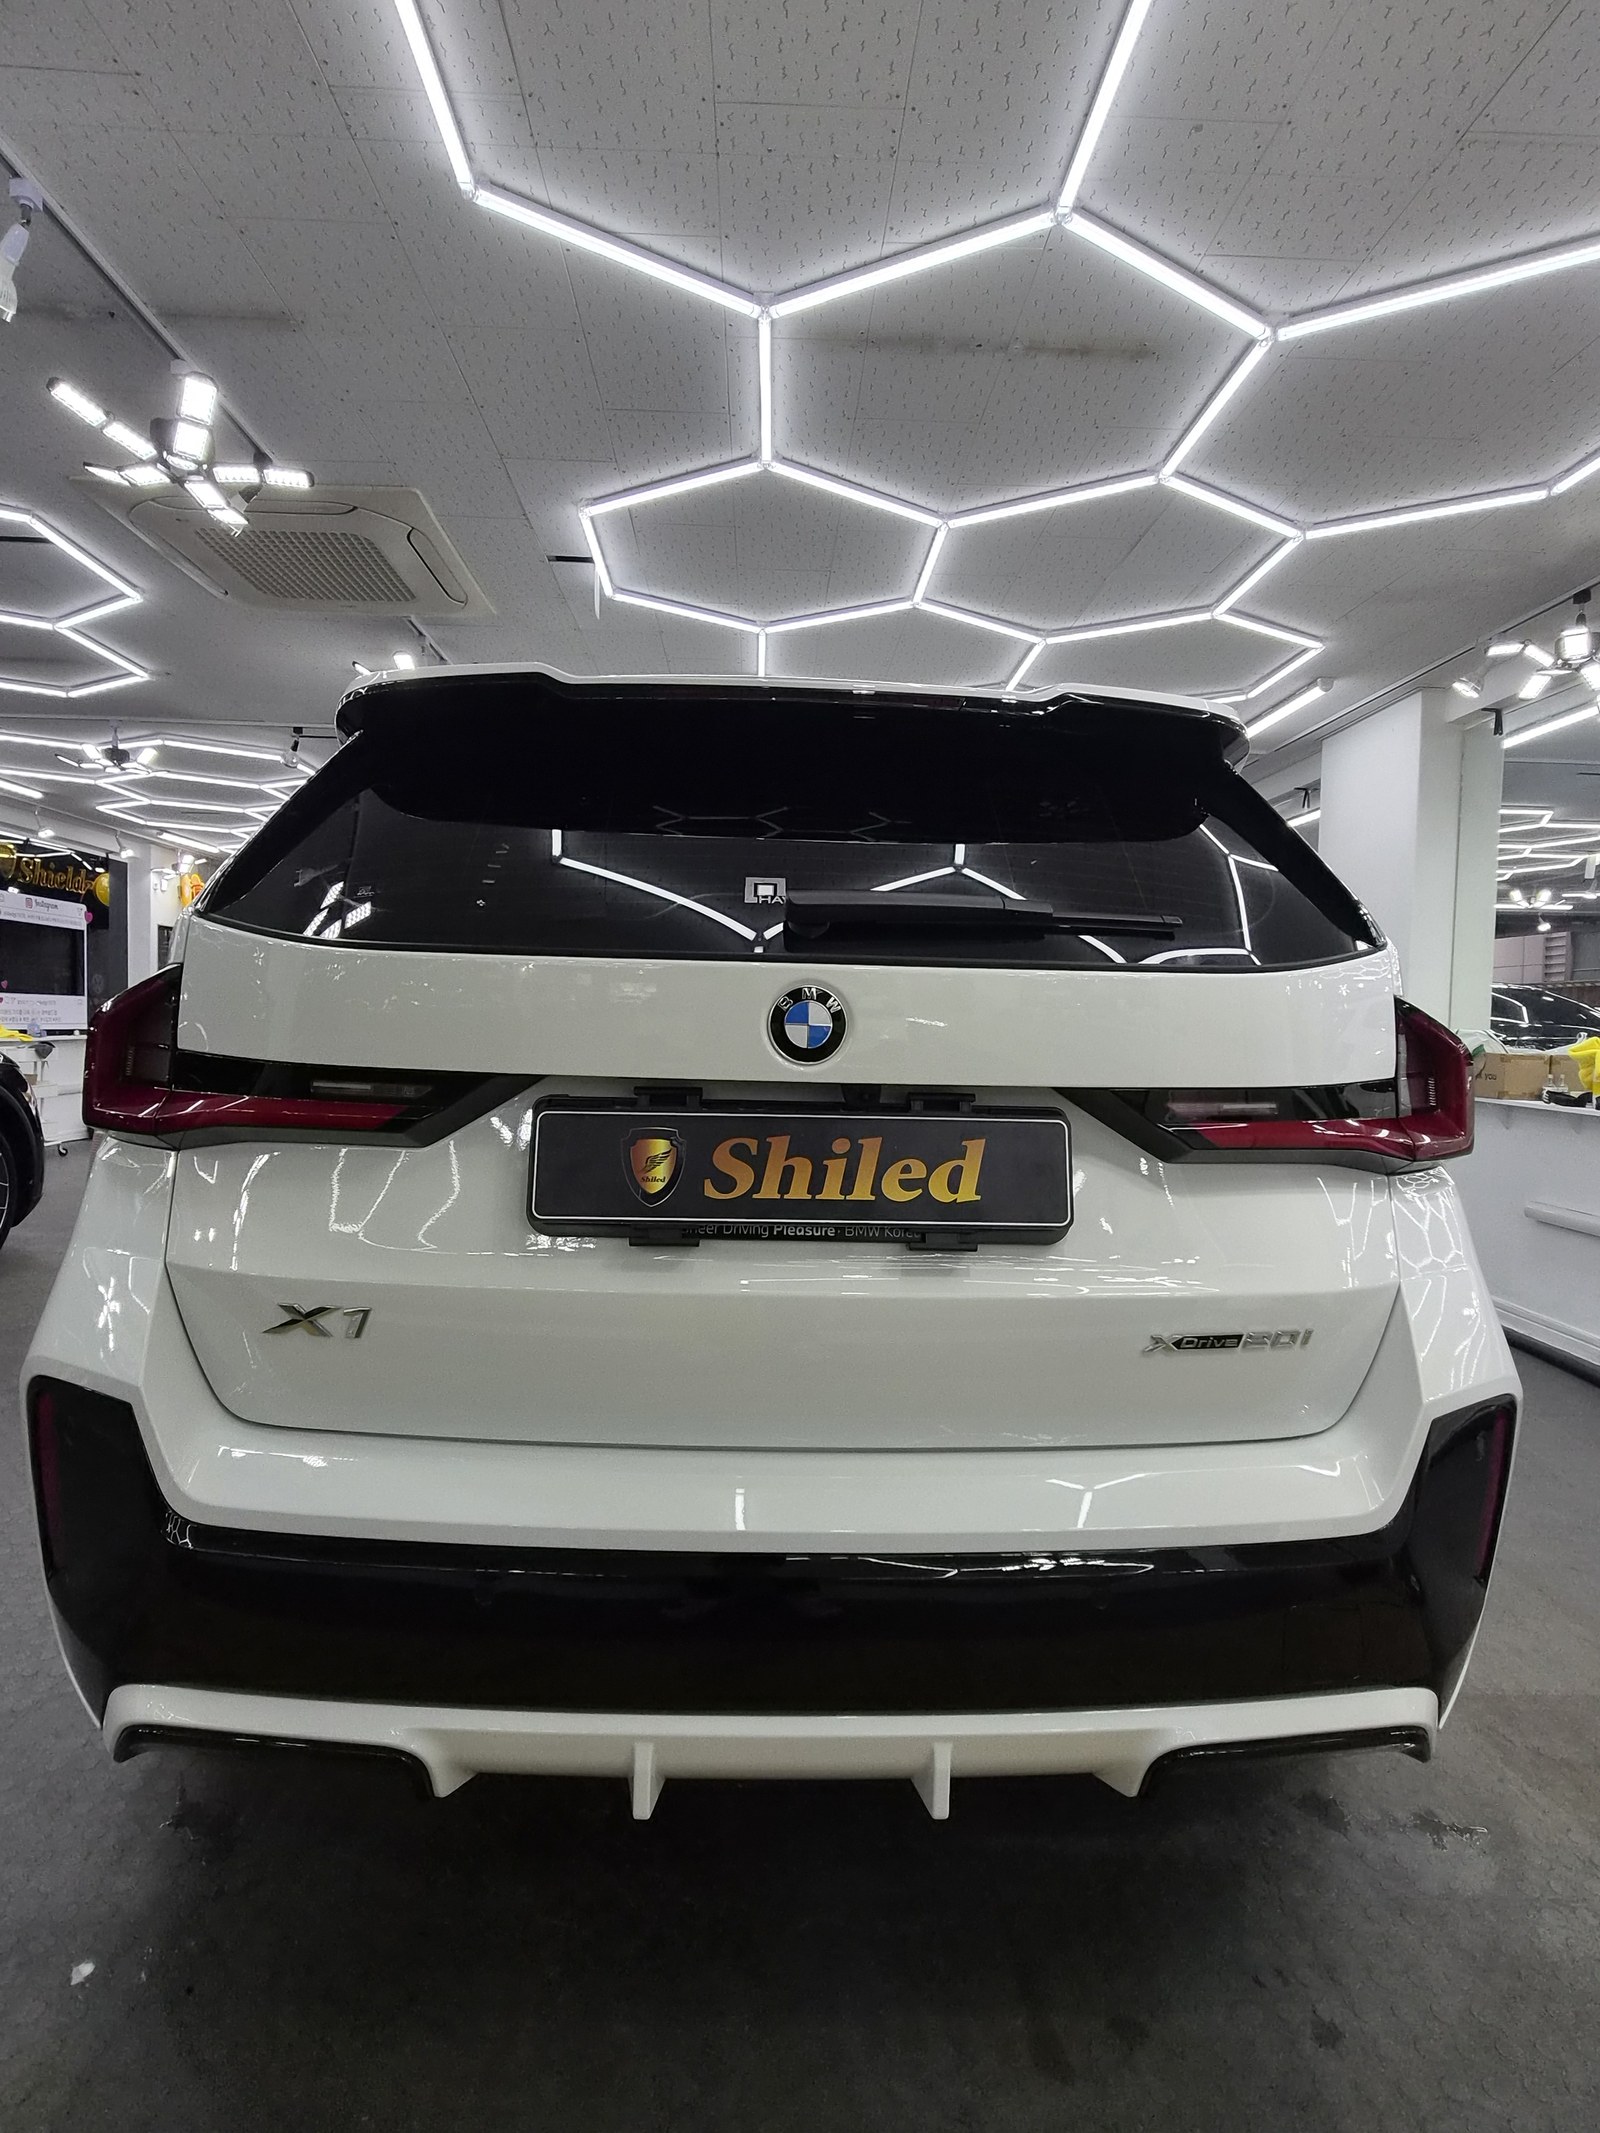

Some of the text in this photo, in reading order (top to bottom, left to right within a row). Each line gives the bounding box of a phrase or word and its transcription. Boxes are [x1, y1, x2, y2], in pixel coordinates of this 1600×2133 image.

[777, 987, 842, 1014] BMW
[703, 1135, 986, 1203] Shiled
[723, 1224, 769, 1238] Driving
[844, 1225, 881, 1238] BMW
